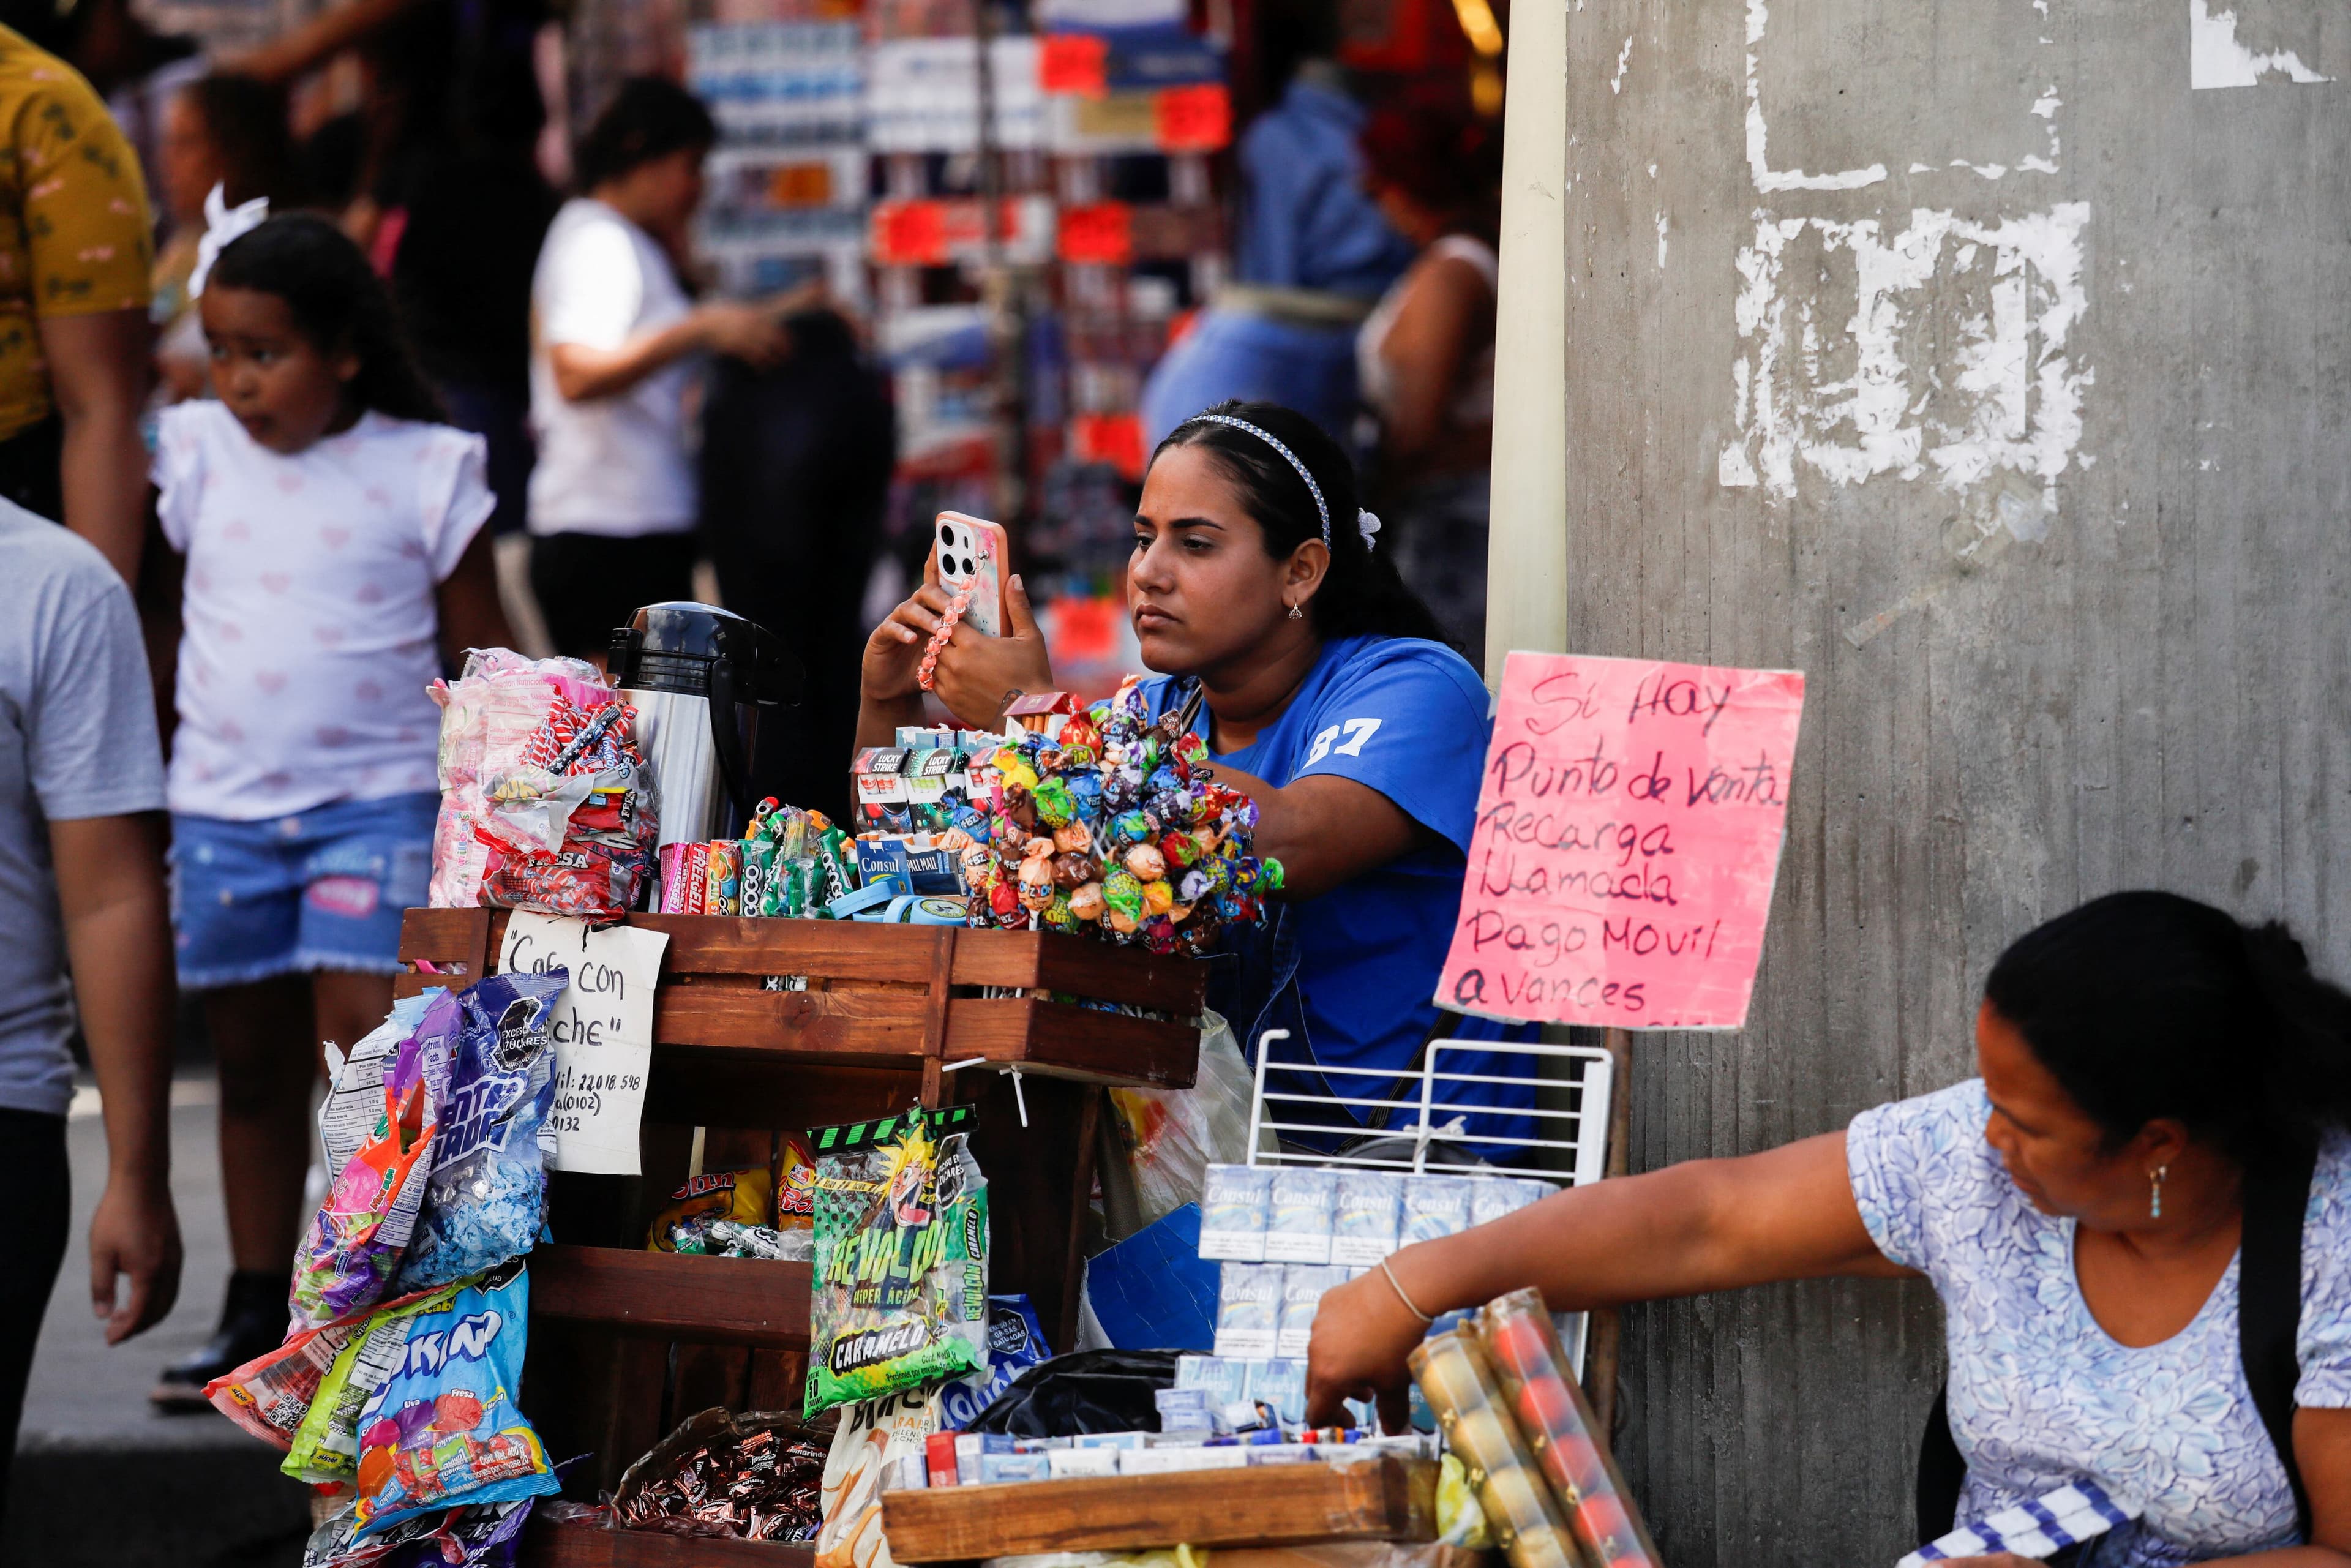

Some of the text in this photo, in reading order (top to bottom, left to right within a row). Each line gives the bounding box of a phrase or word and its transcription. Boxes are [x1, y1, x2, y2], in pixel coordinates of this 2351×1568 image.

[878, 754, 902, 763] LUCKY
[928, 756, 951, 765] LUCKY
[872, 763, 898, 773] STRIKE
[923, 765, 947, 775] STRIKE
[1492, 735, 1619, 797] Punto
[1627, 751, 1672, 804] de
[1479, 801, 1674, 867] Recarga
[861, 857, 899, 872] Consul
[1465, 909, 1586, 967] Pago
[962, 1263, 985, 1321] REVOLCON
[1221, 1283, 1274, 1302] Consul
[836, 1323, 926, 1370] CARAMELO
[451, 1389, 475, 1398] Fresa
[808, 1378, 819, 1400] 50
[404, 1399, 420, 1409] Uva
